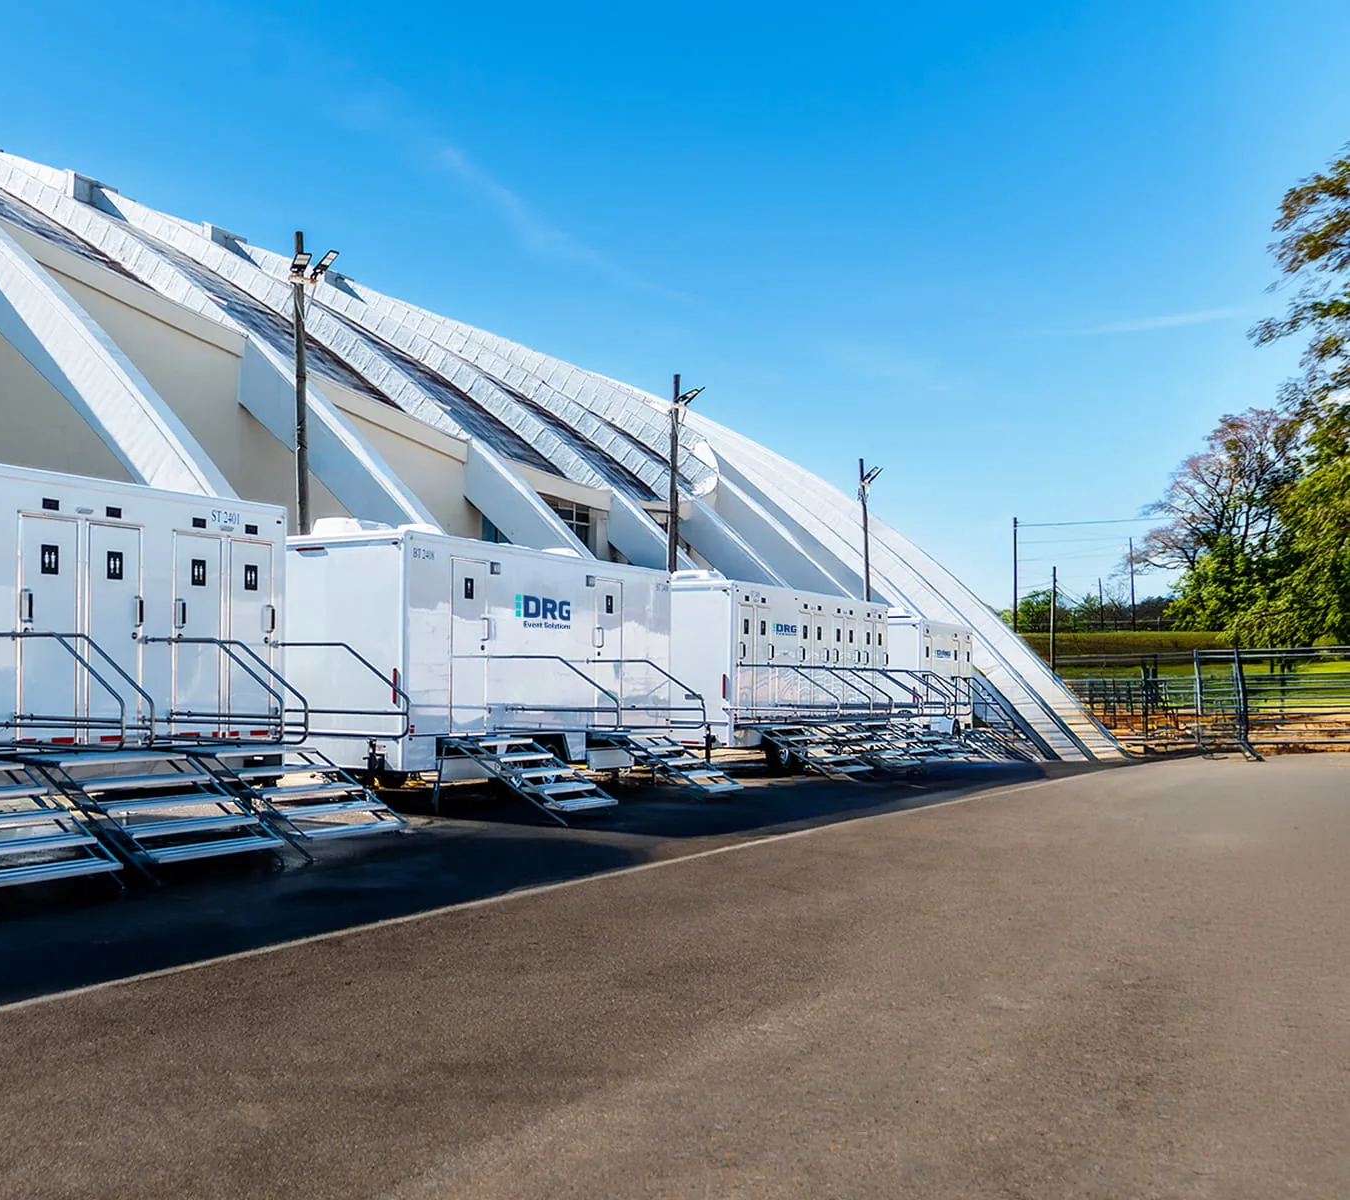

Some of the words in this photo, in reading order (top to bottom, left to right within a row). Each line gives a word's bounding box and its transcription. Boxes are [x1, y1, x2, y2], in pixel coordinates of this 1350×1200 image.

[211, 509, 222, 523] ST
[523, 595, 571, 621] DRG
[776, 623, 797, 633] DRG
